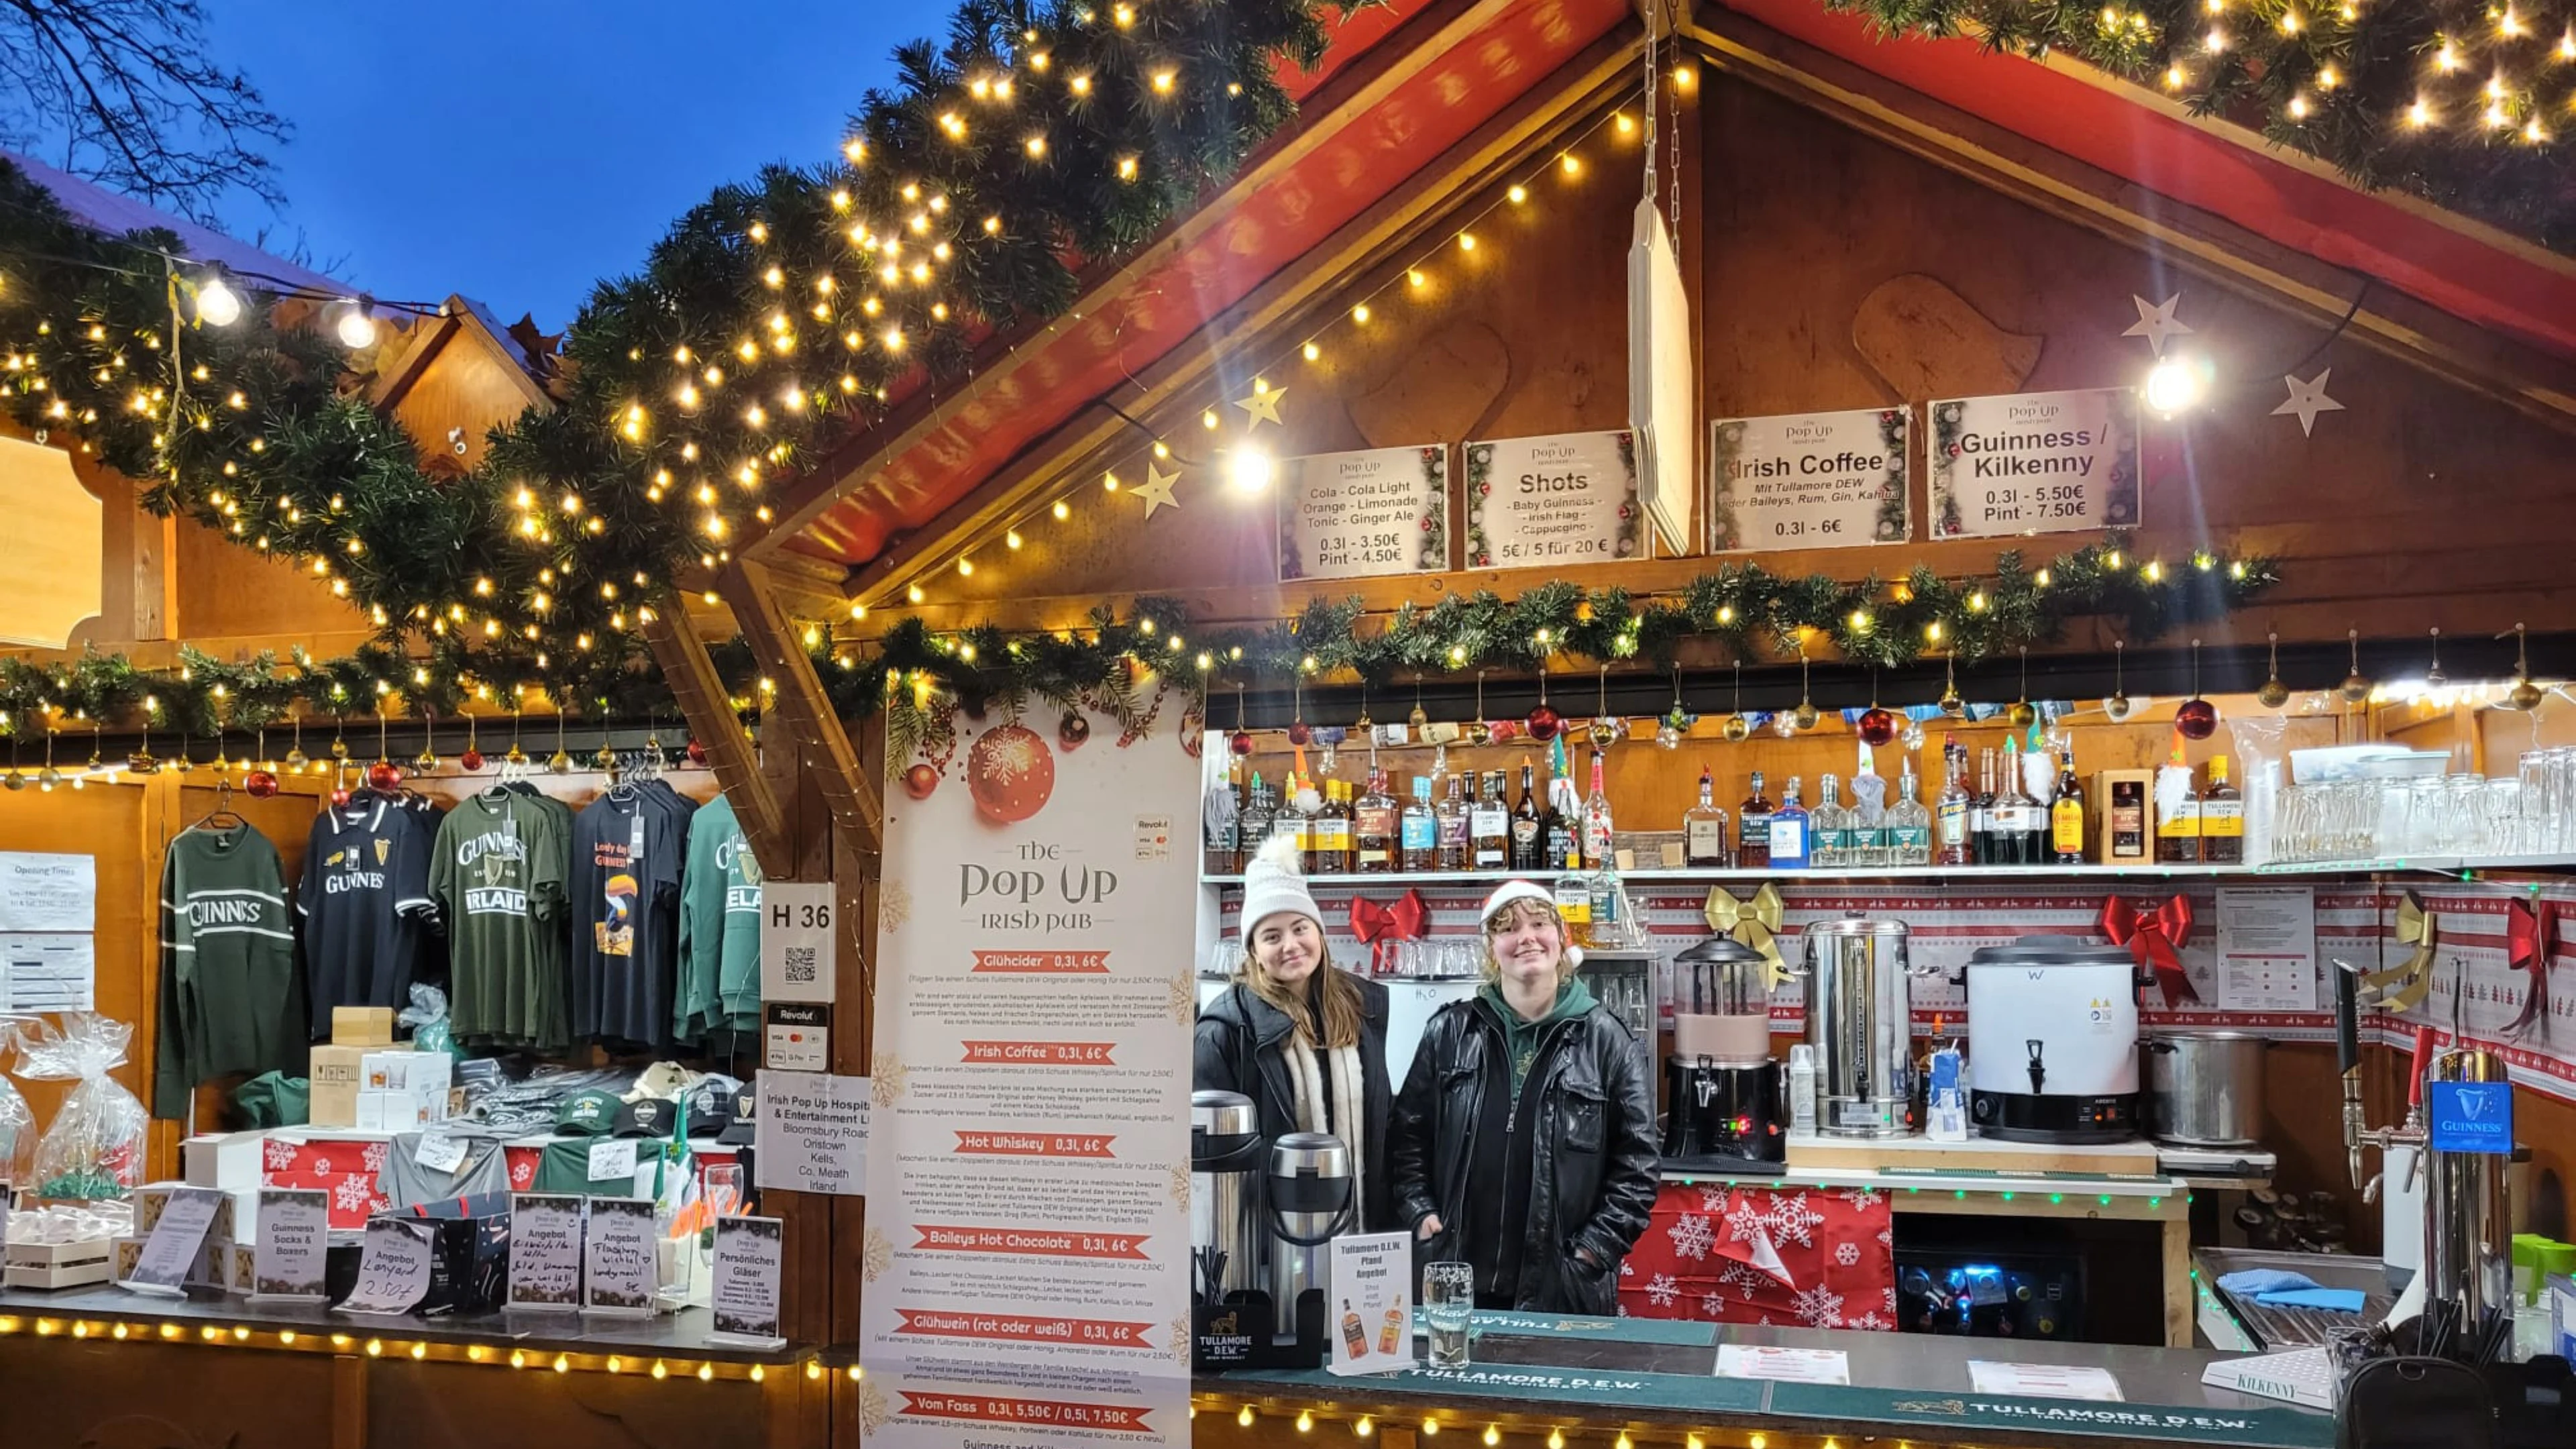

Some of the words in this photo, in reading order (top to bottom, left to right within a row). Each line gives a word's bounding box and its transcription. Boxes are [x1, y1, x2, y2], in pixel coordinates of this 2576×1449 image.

[1961, 431, 2091, 453] Guinness
[2100, 423, 2108, 444] /
[1737, 457, 1790, 478] Irish
[1800, 452, 1883, 474] Coffee
[1975, 455, 2094, 477] Kilkenny
[1310, 488, 1337, 498] Cola
[1348, 484, 1375, 496] Cola
[1379, 481, 1411, 495] Light
[1520, 472, 1588, 493] Shots
[1755, 484, 1772, 493] Mit
[1776, 482, 1832, 492] Tullamore
[1835, 478, 1865, 488] DEW
[1750, 496, 1794, 507] Baileys,
[1798, 494, 1827, 504] Rum,
[1831, 492, 1854, 502] Gin,
[2036, 484, 2084, 501] 5.50€
[1303, 502, 1346, 515] Orange
[1358, 496, 1418, 510] Limonade
[1513, 501, 1540, 511] Baby
[2038, 502, 2086, 518] 7.50€
[1308, 516, 1339, 528] Tonic
[1350, 513, 1391, 525] Ginger
[1394, 510, 1414, 521] Ale
[1822, 519, 1842, 533] 6€
[1360, 533, 1400, 548] 3.50€
[1362, 548, 1401, 563] 4.50€
[1503, 544, 1520, 558] 5€
[1534, 543, 1543, 556] 5
[1548, 542, 1570, 555] für
[1575, 540, 1593, 553] 20
[1599, 539, 1608, 552] €
[773, 904, 790, 927] H
[801, 905, 830, 928] 36
[983, 955, 1043, 967] Glühcider
[1082, 955, 1098, 967] 6€
[780, 1010, 813, 1020] Revolut
[974, 1045, 1002, 1057] Irish
[1005, 1045, 1046, 1058] Coffee
[1087, 1048, 1102, 1059] 6€
[767, 1093, 789, 1105] Irish
[792, 1096, 812, 1108] Pop
[814, 1098, 828, 1110] Up
[774, 1108, 781, 1118] &
[784, 1110, 857, 1124] Entertainment
[783, 1122, 839, 1139] Bloomsbury
[2442, 1120, 2502, 1133] GUINNESS
[965, 1136, 989, 1148] Hot
[992, 1136, 1044, 1152] Whiskey
[1084, 1140, 1100, 1152] 6€
[798, 1166, 815, 1176] Co.
[818, 1167, 849, 1179] Meath
[810, 1180, 837, 1192] Irland
[272, 1224, 315, 1233] Guinness
[528, 1230, 566, 1240] Angebot
[274, 1235, 303, 1244] Socks
[604, 1234, 641, 1244] Angebot
[930, 1231, 975, 1246] Baileys
[979, 1233, 1002, 1246] Hot
[1006, 1234, 1072, 1250] Chocolate
[1112, 1240, 1128, 1252] 6€
[276, 1246, 309, 1255] Boxers
[1341, 1244, 1379, 1254] Tullamore
[376, 1251, 415, 1265] Angebot
[720, 1252, 775, 1266] Persönliches
[363, 1259, 419, 1277] Lanyard
[733, 1267, 762, 1278] Gläser
[1356, 1268, 1387, 1279] Angebot
[914, 1315, 969, 1330] Glühwein
[973, 1317, 998, 1333] (rot
[1002, 1320, 1031, 1334] oder
[1034, 1322, 1072, 1338] weiß)
[1113, 1326, 1130, 1340] 6€
[1199, 1336, 1252, 1345] TULLAMORE
[1411, 1368, 1562, 1385] TULLAMORE
[2238, 1373, 2298, 1398] KILKENNY
[917, 1397, 943, 1410] Vom
[947, 1399, 977, 1413] Fass
[1017, 1403, 1051, 1418] 5,50€
[1055, 1406, 1061, 1421] /
[1093, 1409, 1128, 1424] 7,50€
[1969, 1403, 2156, 1425] TULLAMORE
[963, 1439, 1012, 1449] Guinness
